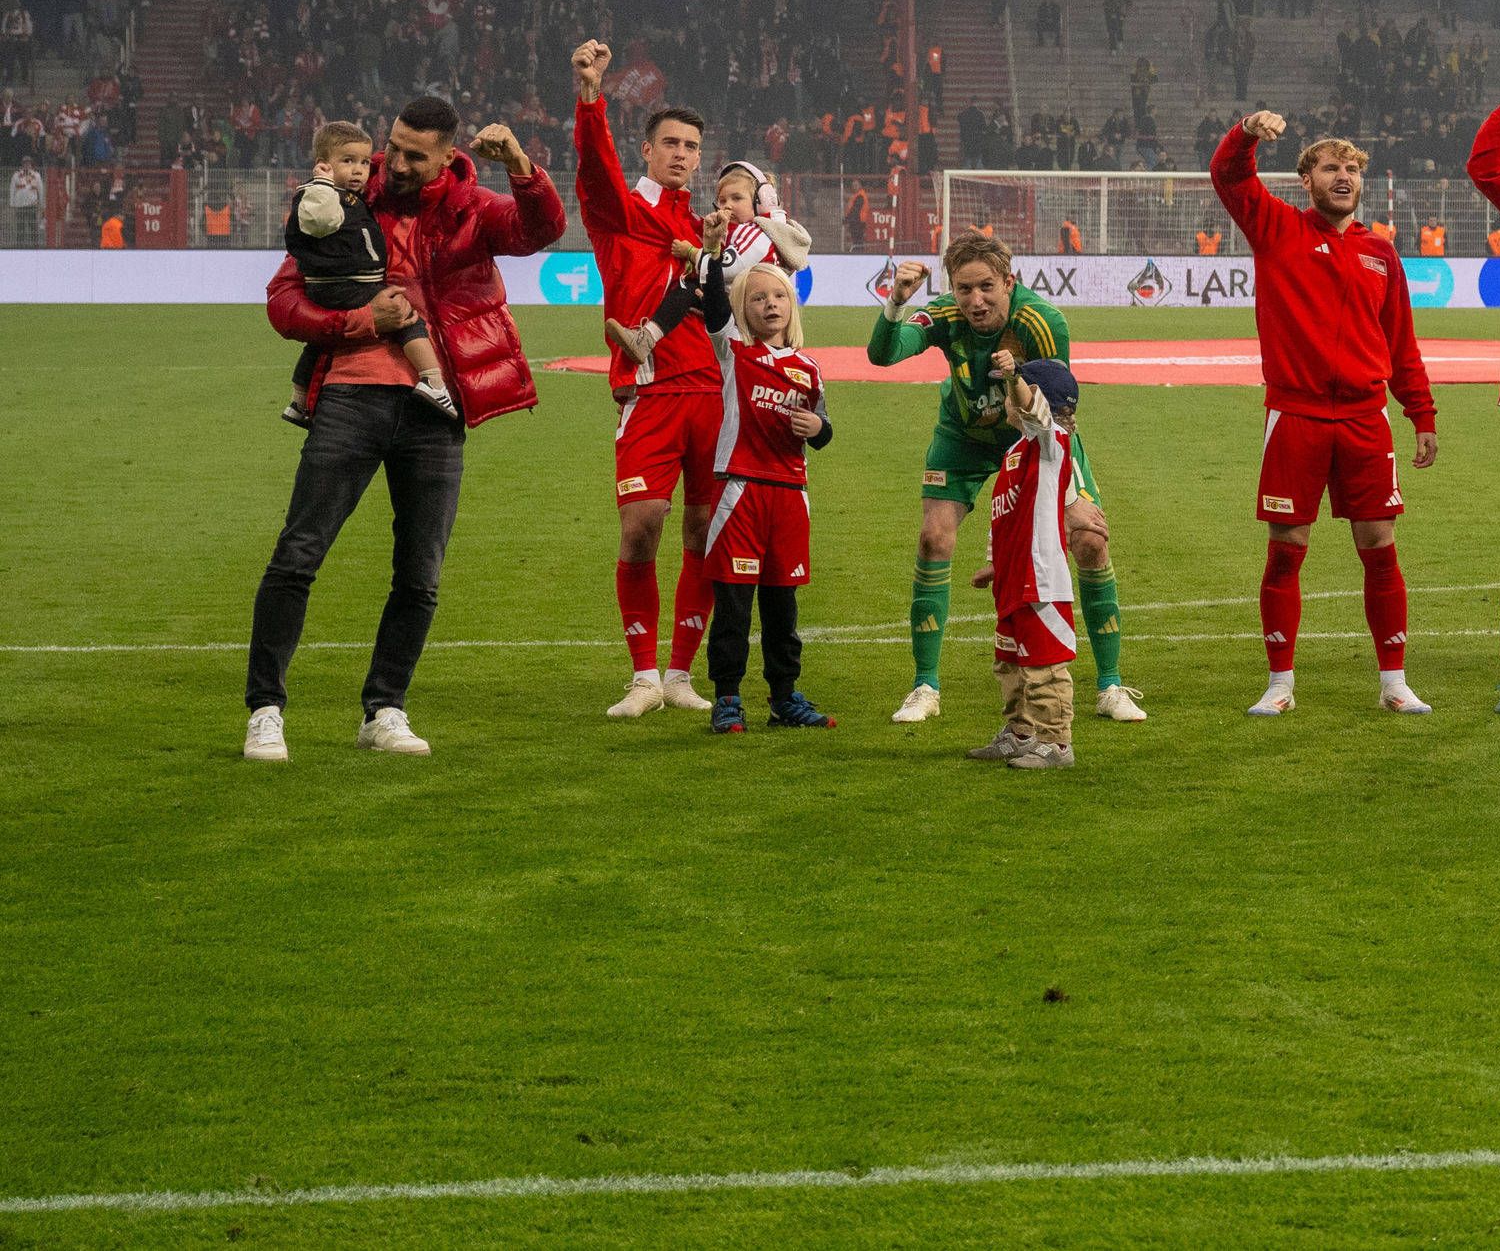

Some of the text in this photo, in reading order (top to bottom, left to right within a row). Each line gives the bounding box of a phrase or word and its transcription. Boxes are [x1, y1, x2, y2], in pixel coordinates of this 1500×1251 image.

[142, 203, 162, 215] Tor
[872, 212, 892, 224] Tor
[143, 220, 161, 232] 10
[874, 229, 888, 240] 11
[756, 401, 774, 410] ALTE
